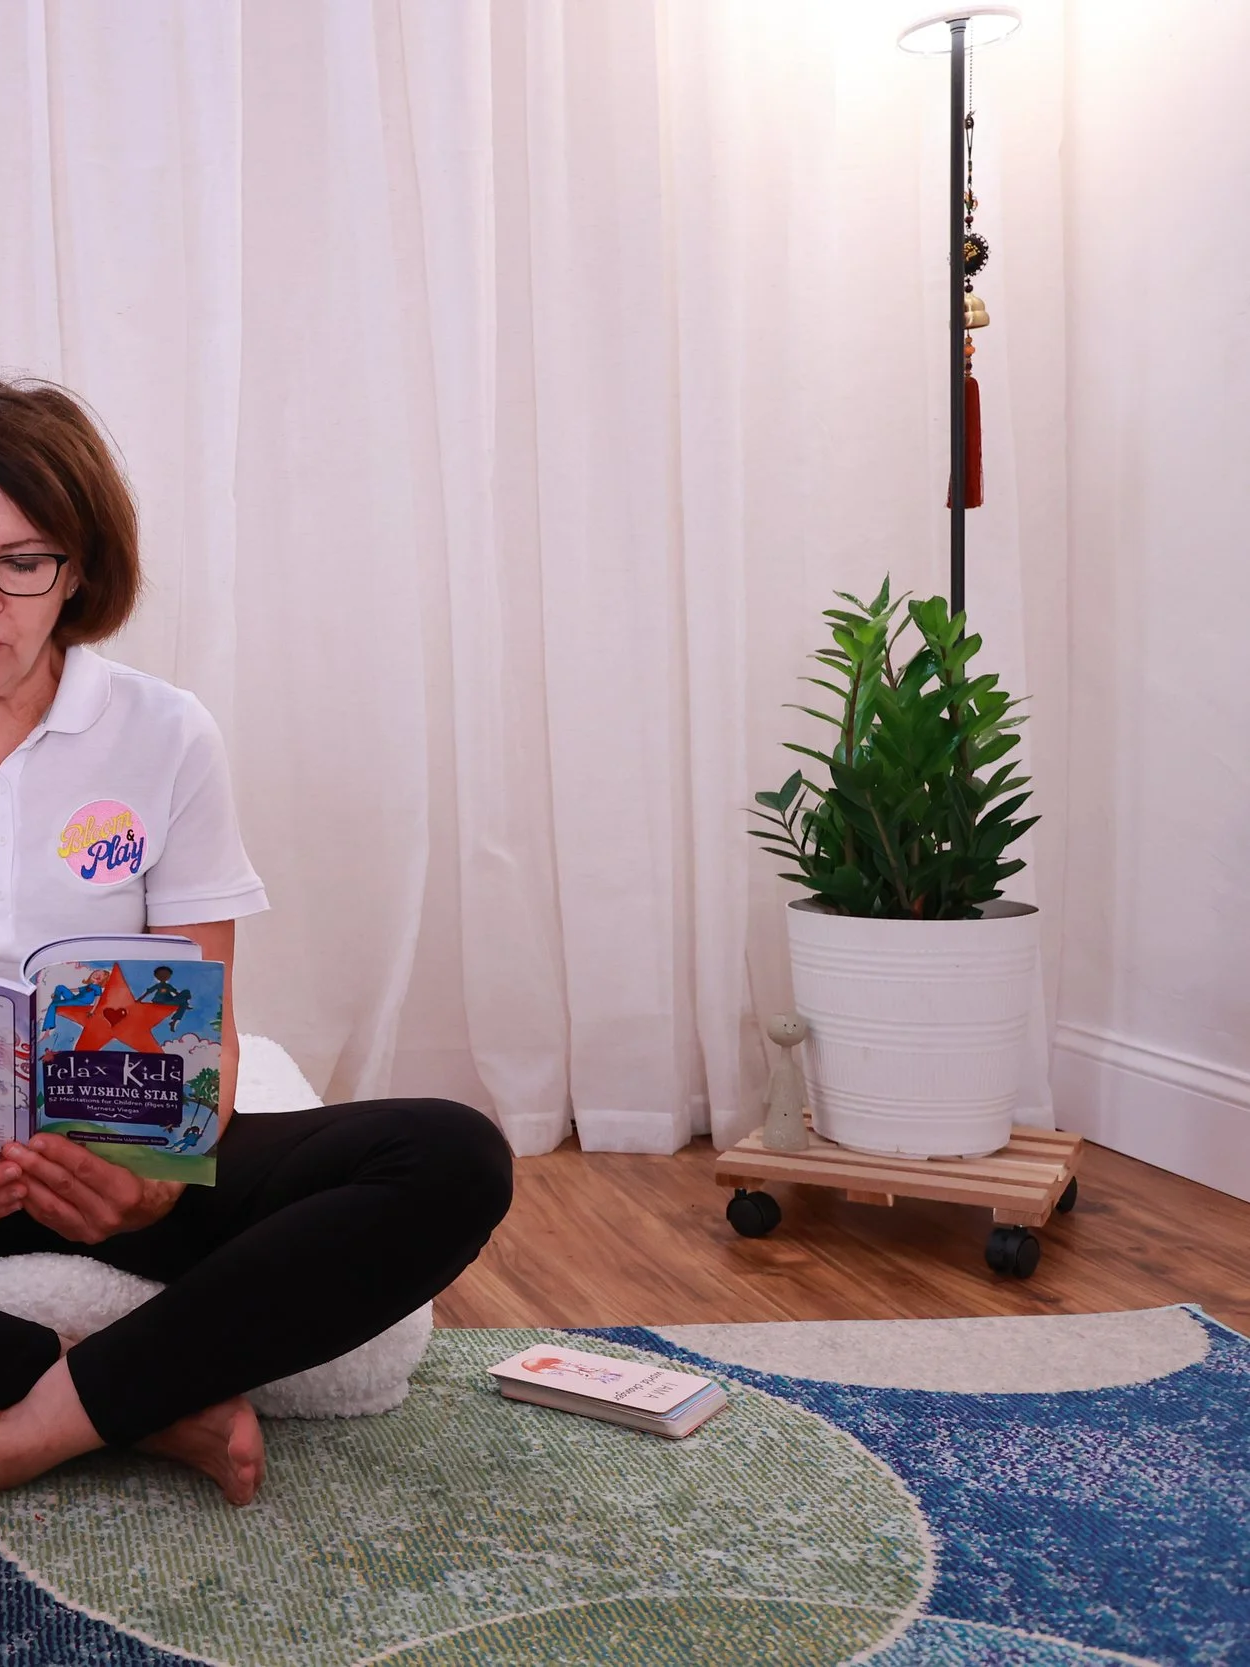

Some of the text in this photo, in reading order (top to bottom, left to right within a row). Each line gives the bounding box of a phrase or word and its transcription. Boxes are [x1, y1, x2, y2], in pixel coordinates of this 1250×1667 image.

[58, 811, 135, 858] Bloom &
[81, 835, 144, 879] Play
[47, 1054, 181, 1087] relax Kids
[48, 1086, 178, 1101] THE WISHING STAR
[640, 1371, 664, 1386] world
